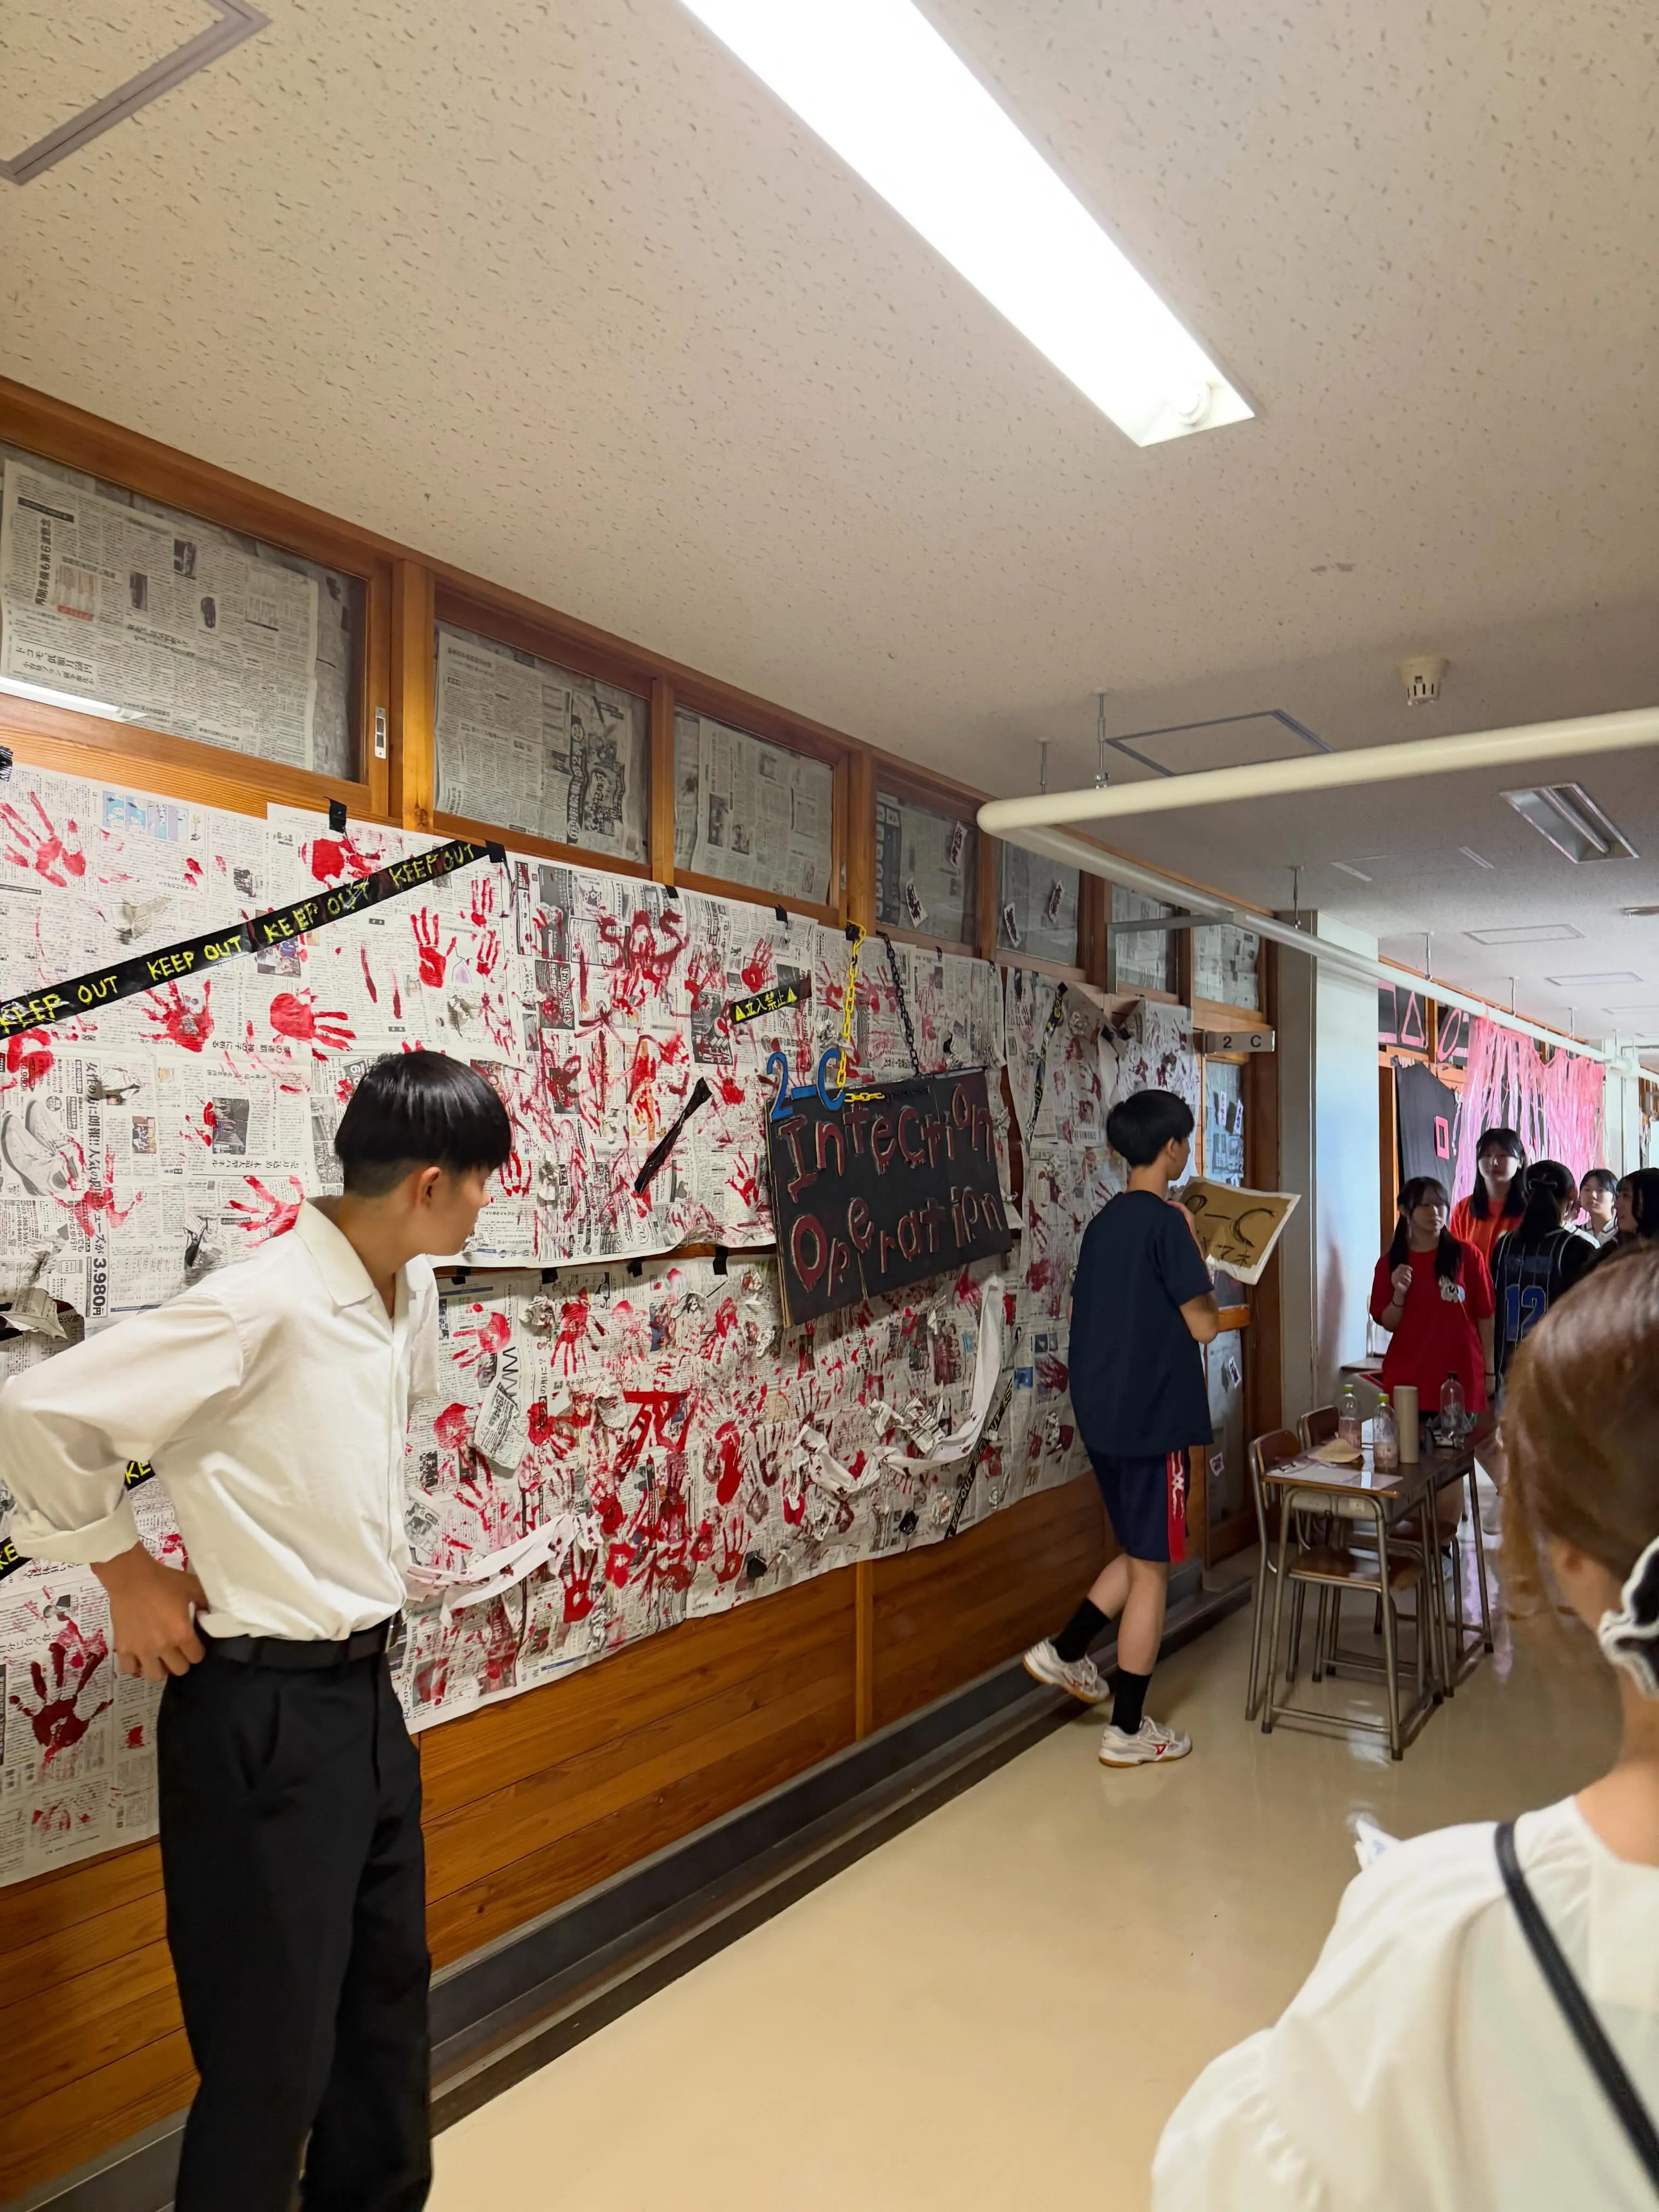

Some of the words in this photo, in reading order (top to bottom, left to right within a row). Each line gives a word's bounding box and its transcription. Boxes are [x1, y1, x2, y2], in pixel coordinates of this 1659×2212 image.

[389, 854, 437, 888] KEEP
[443, 844, 475, 871] OUT
[264, 902, 318, 943] KEEP
[327, 882, 370, 916] OUT
[147, 950, 193, 981] KEEP
[204, 935, 243, 961] OUT
[78, 976, 118, 1004] OUT
[745, 990, 786, 1018] 立入禁止
[1223, 1036, 1232, 1049] 2
[1250, 1035, 1262, 1048] C
[766, 1048, 845, 1122] 2-C
[791, 1186, 1003, 1297] Operation
[92, 1257, 107, 1316] 3,980円
[1506, 1284, 1547, 1341] 12
[125, 1462, 151, 1485] KE
